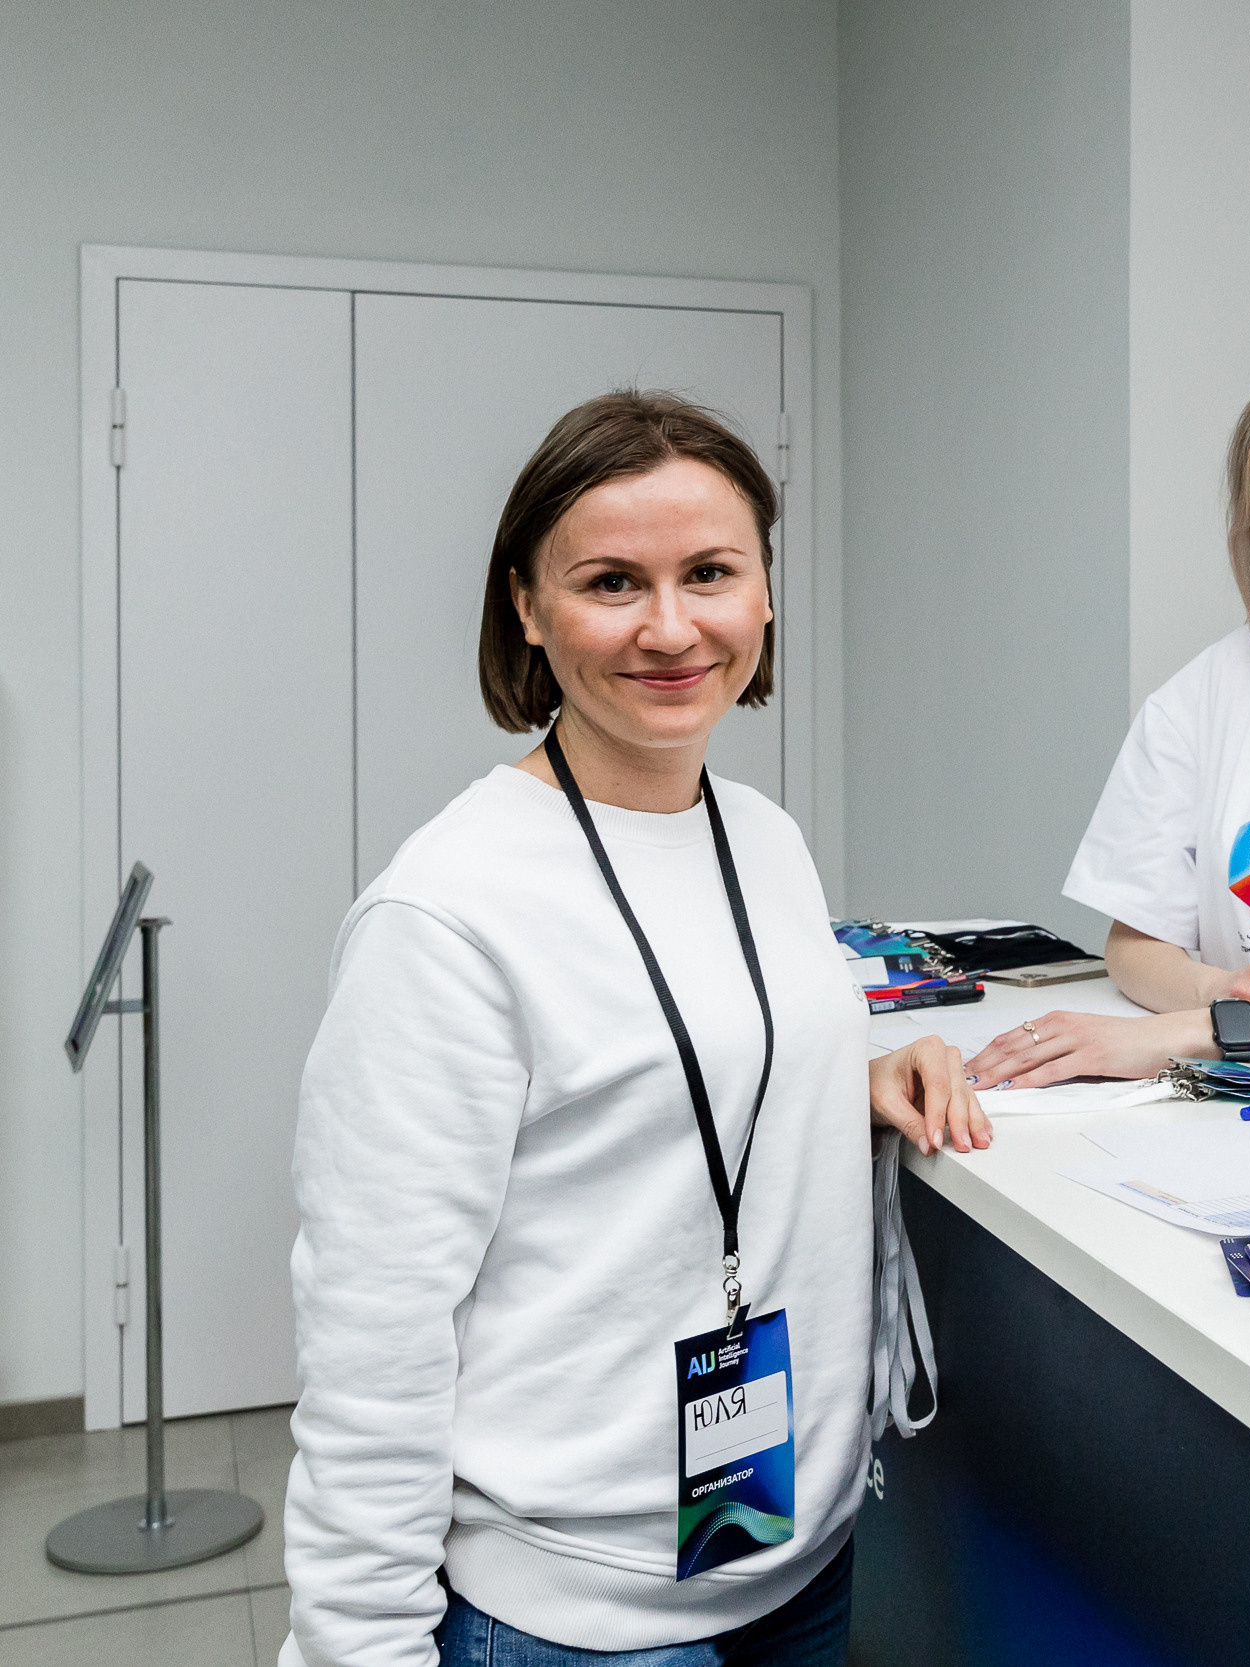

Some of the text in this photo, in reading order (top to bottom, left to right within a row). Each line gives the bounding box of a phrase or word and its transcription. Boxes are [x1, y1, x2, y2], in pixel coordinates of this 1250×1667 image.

[718, 1342, 741, 1355] Artificial
[718, 1348, 749, 1362] Intelligence
[687, 1351, 716, 1379] AIJ
[719, 1358, 740, 1369] Journey
[694, 1386, 747, 1431] ЮЛЯ
[692, 1468, 754, 1497] ОРГАНИЗАТОР
